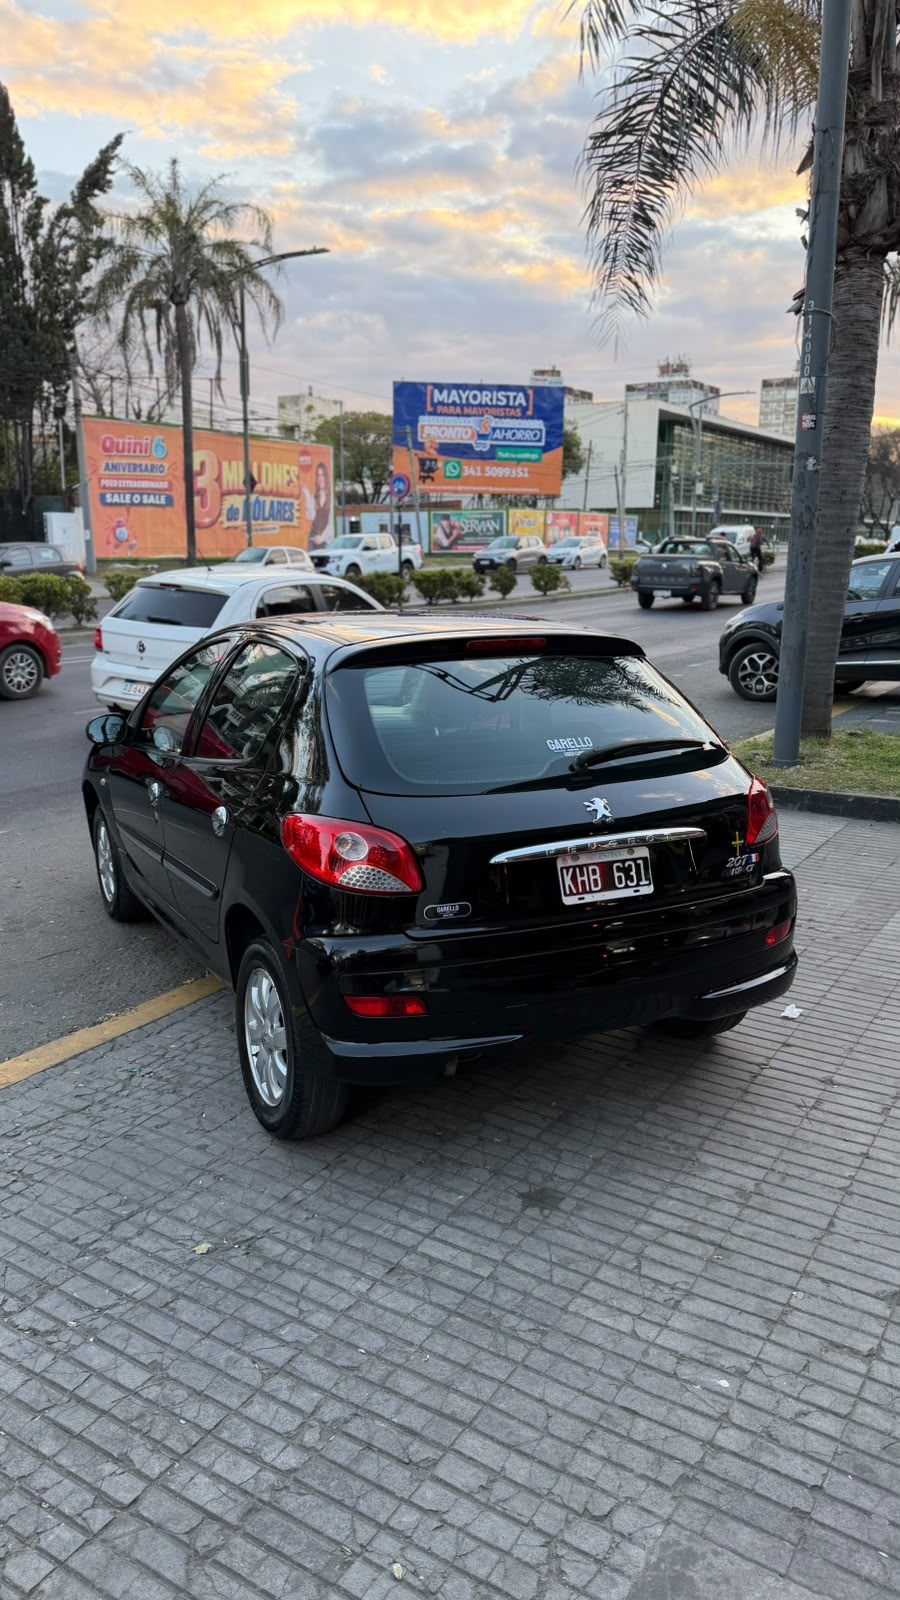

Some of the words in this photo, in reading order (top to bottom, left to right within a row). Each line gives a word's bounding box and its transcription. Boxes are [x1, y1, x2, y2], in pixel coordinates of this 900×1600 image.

[433, 388, 527, 407] MAYORISTA
[436, 406, 461, 415] PARA
[463, 407, 522, 417] MAYORISTAS
[423, 425, 472, 440] PRONTO
[493, 428, 541, 442] AHORRO
[101, 434, 151, 457] Quini
[152, 435, 169, 460] 6
[103, 461, 165, 474] ANIVERSARIO
[463, 464, 482, 477] 341
[486, 465, 529, 479] 5099351
[192, 449, 221, 529] 3
[222, 460, 299, 493] MILONES
[105, 493, 131, 504] SALE
[132, 493, 141, 504] O
[142, 494, 167, 505] SALE
[226, 504, 240, 521] de
[546, 736, 593, 751] GARELLO
[545, 832, 672, 857] PEUGEOT
[726, 854, 749, 868] 207
[562, 864, 602, 896] KHB
[612, 859, 650, 891] 631
